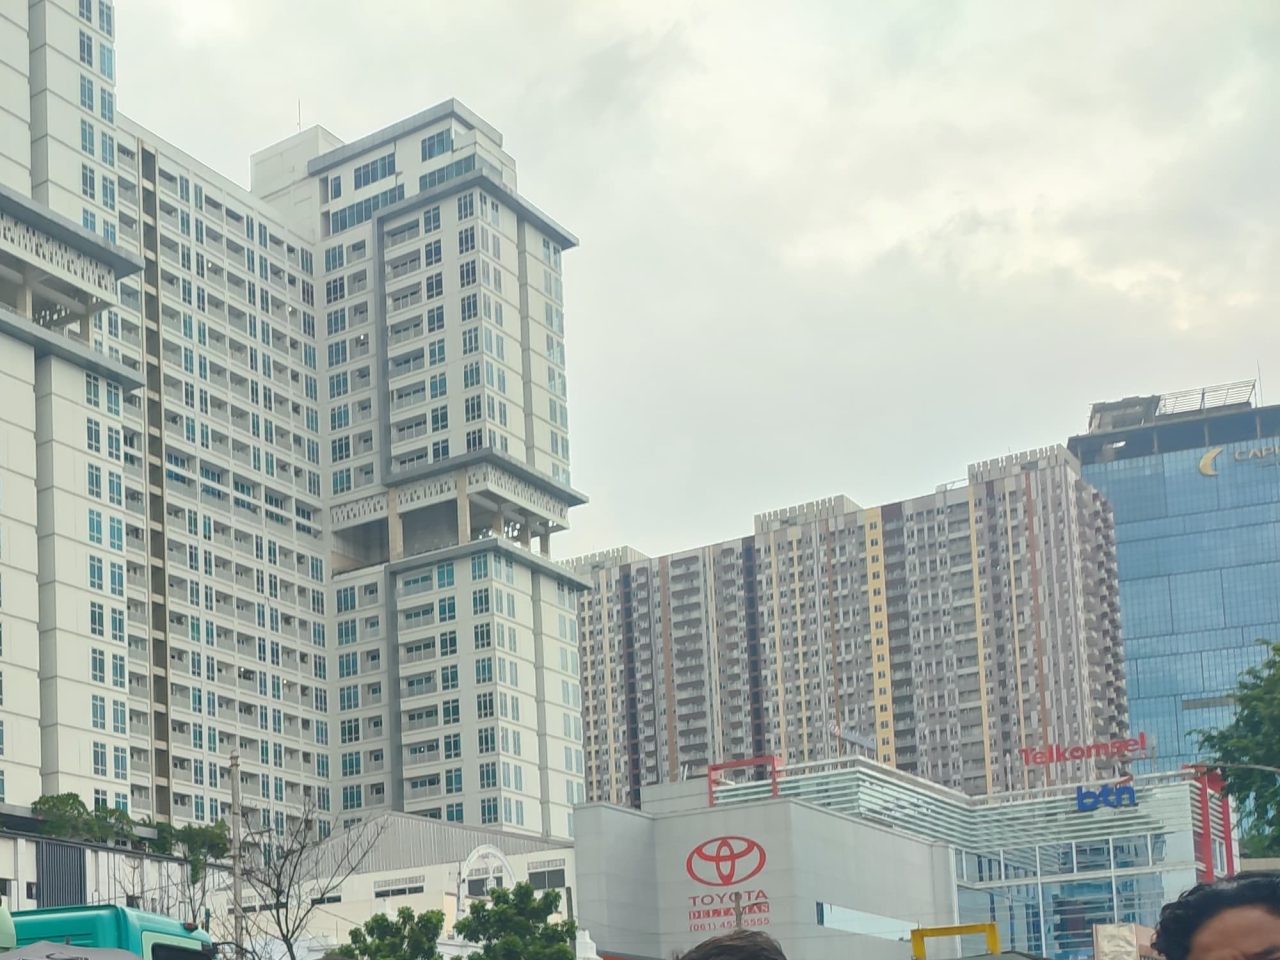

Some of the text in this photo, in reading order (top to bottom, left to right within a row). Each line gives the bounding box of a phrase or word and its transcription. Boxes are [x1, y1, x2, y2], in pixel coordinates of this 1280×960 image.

[1019, 731, 1146, 766] Telkomsel
[1076, 784, 1135, 812] btn
[688, 890, 768, 906] TOYOTA
